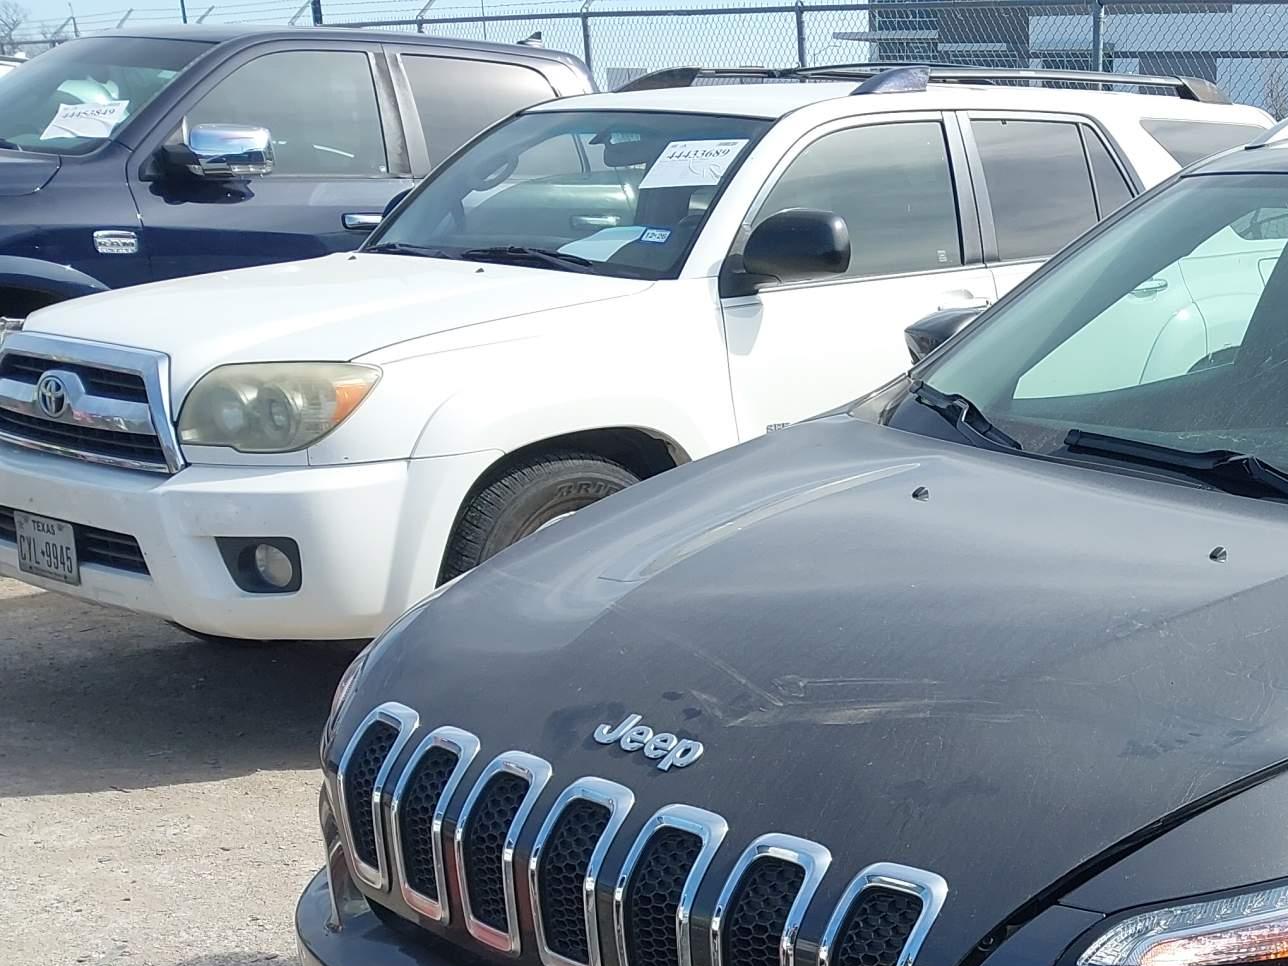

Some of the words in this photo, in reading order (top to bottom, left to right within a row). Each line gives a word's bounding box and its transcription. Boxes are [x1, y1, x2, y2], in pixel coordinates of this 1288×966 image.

[666, 148, 731, 161] 44433689
[31, 519, 56, 536] TEXAS
[593, 713, 705, 772] Jeep
